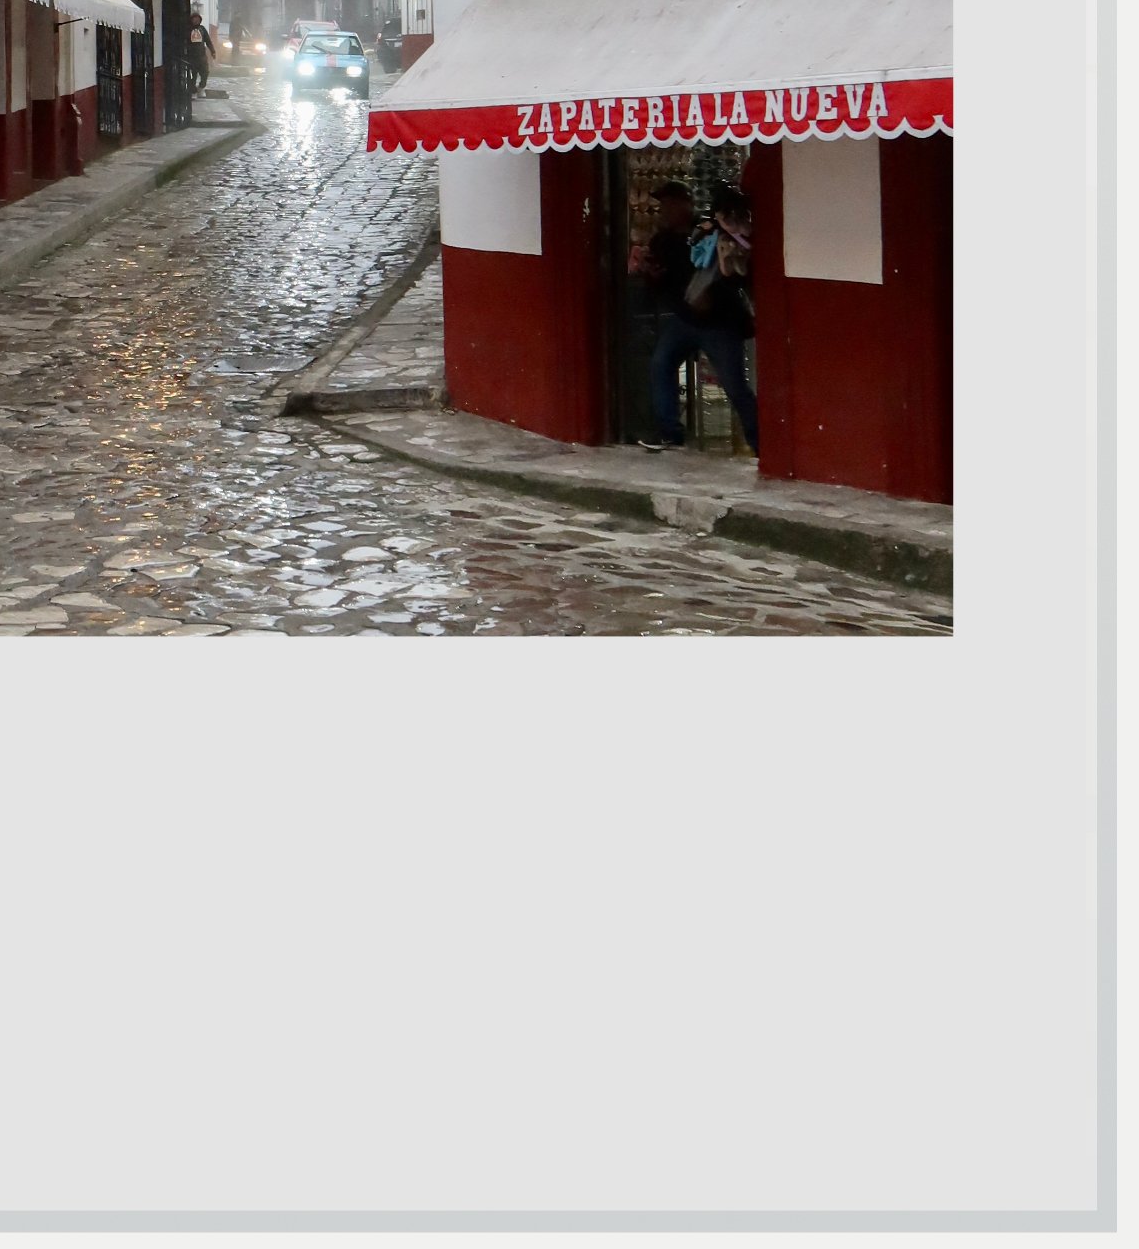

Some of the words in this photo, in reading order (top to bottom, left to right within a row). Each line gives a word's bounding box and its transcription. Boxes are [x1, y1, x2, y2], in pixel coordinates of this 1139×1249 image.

[517, 94, 704, 136] ZAPATERIA
[713, 91, 749, 126] LA
[764, 82, 889, 123] NUEVA
